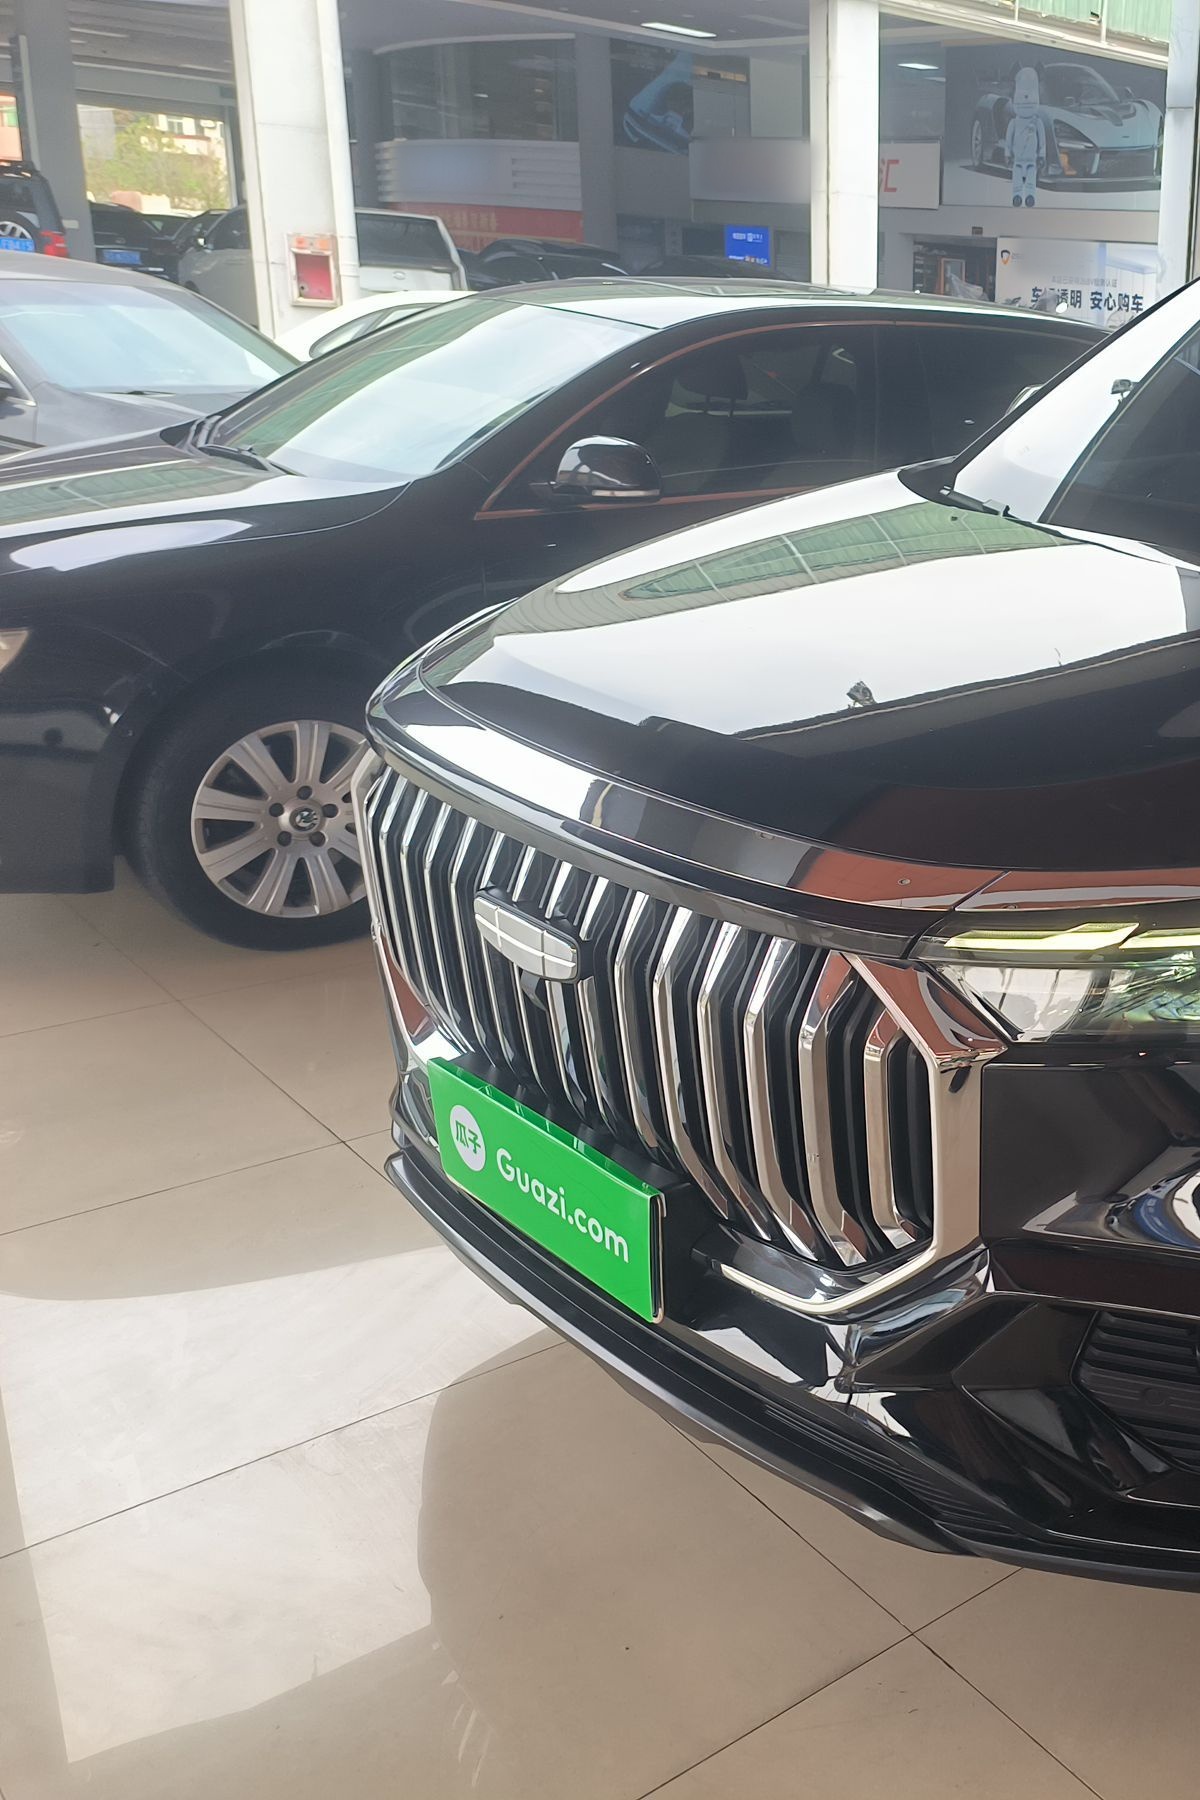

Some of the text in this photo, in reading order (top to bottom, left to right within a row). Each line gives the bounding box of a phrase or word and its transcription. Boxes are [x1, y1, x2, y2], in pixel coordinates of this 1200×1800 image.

[1090, 291, 1144, 313] 安心购车
[455, 1119, 482, 1155] 瓜子
[496, 1147, 630, 1264] Guazi.com
